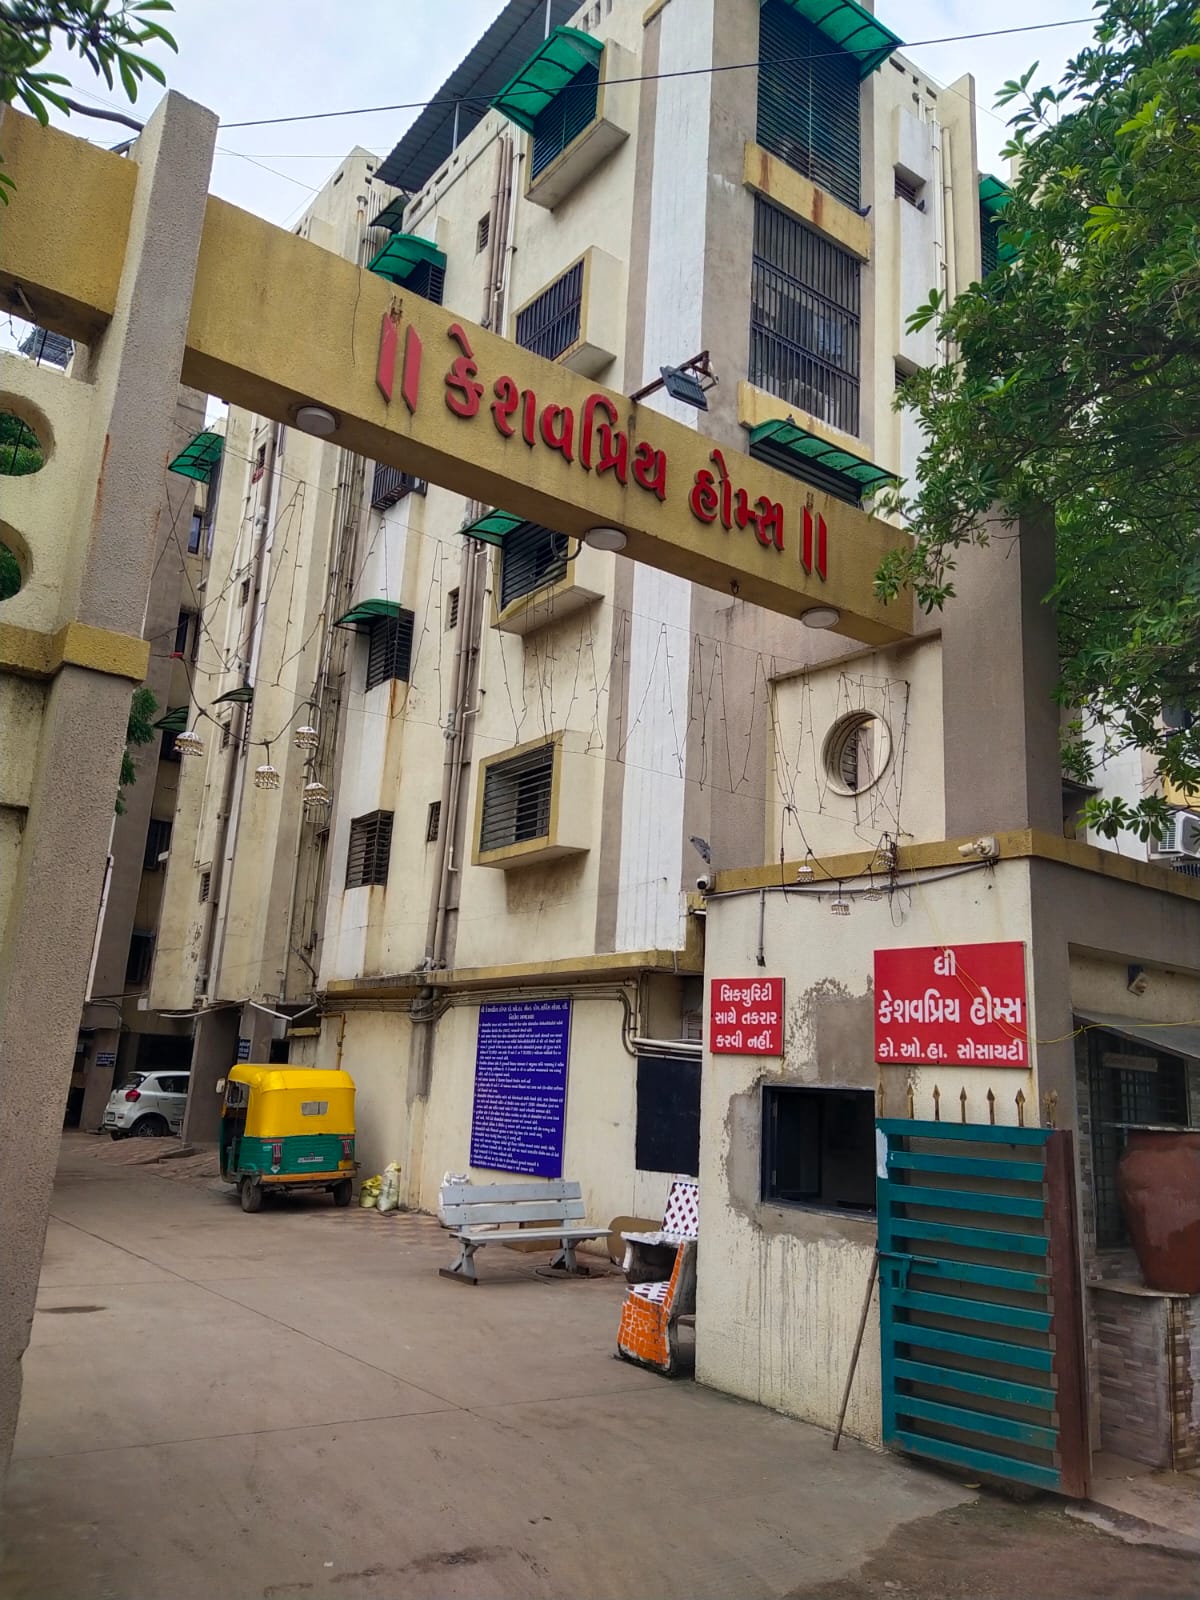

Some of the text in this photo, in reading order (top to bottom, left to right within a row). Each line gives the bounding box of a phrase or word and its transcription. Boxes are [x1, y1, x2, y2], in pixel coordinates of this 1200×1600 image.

[445, 323, 667, 501] કેશવપ્રિય
[689, 448, 785, 552] હોમ્સ
[715, 1006, 777, 1025] સાથે તકરાર
[878, 986, 1021, 1025] કેશવપ્રિય હોમ્સ
[715, 1029, 742, 1048] કરવી
[957, 1037, 1024, 1061] સોસાયટી
